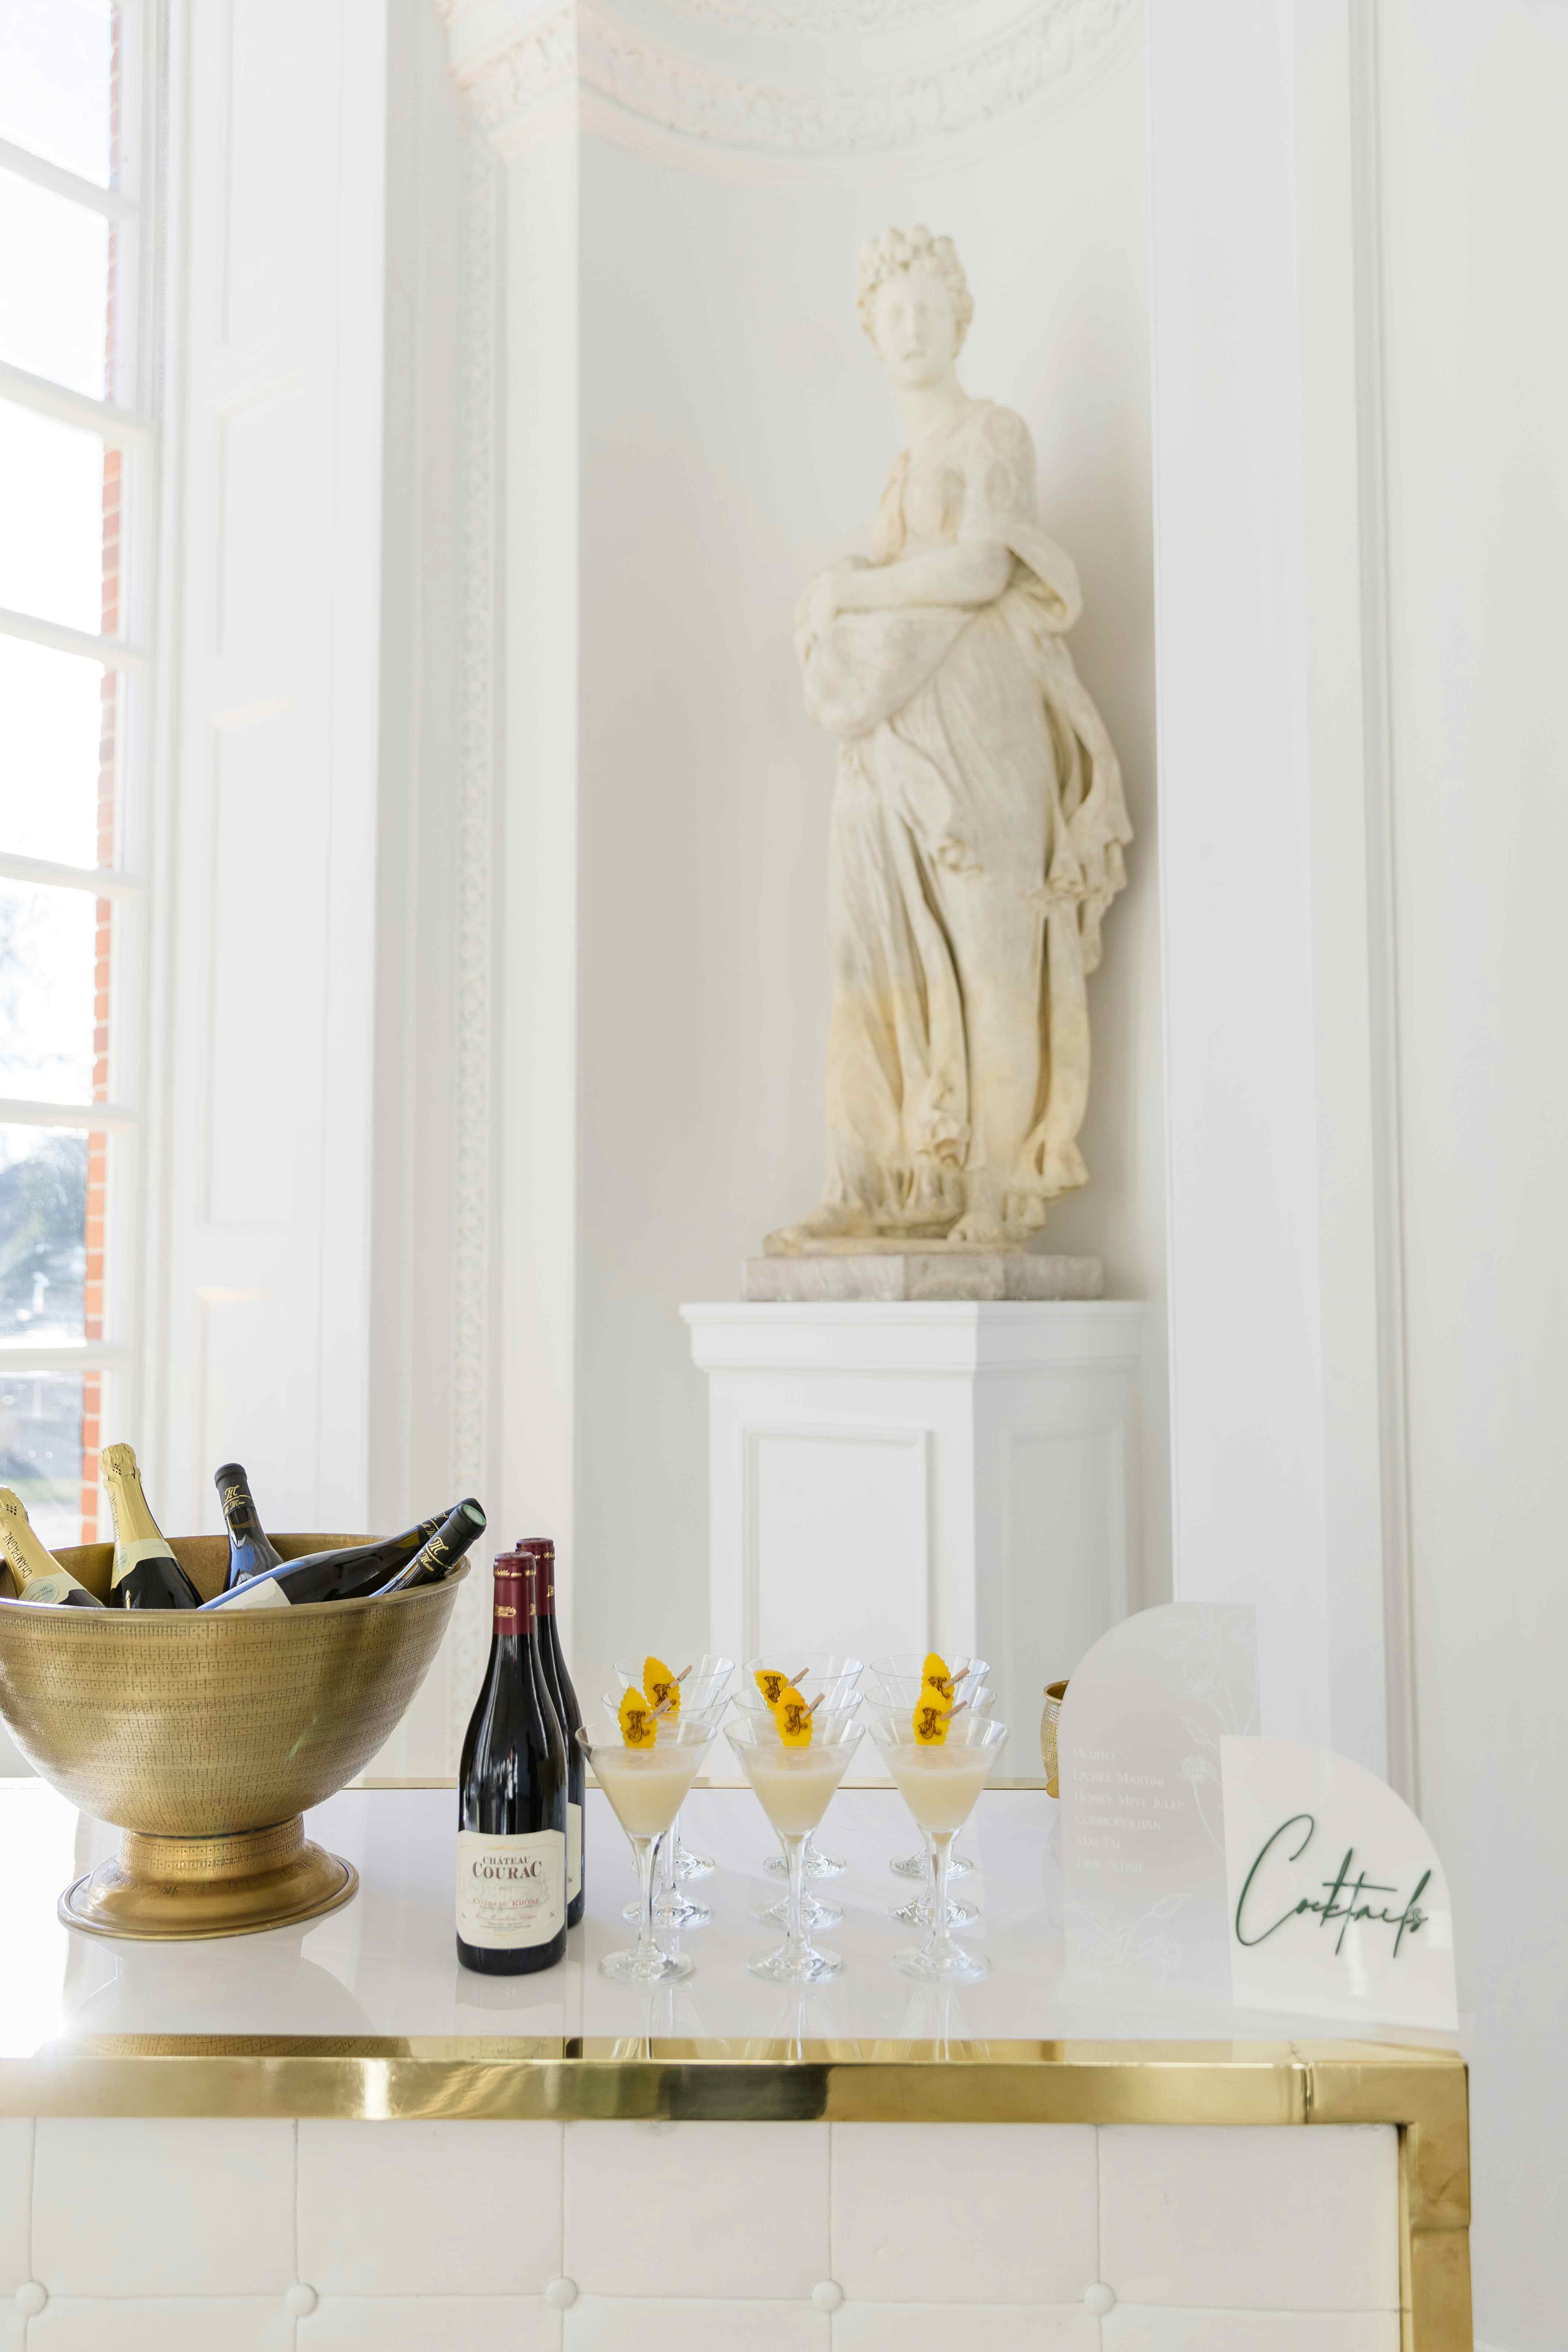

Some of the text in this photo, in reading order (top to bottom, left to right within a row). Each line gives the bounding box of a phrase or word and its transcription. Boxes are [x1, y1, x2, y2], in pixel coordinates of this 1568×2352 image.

[3, 1531, 32, 1578] CHAMPAGNE
[1117, 1772, 1165, 1787] MARTINI
[1074, 1790, 1113, 1805] HONEY
[1118, 1793, 1147, 1808] MINT
[1074, 1812, 1162, 1831] COSMOPOLITAN
[1076, 1834, 1121, 1849] MAI TAI
[472, 1861, 542, 1879] COURAC
[1077, 1856, 1102, 1869] LIME
[1235, 1814, 1431, 1958] Cocktails
